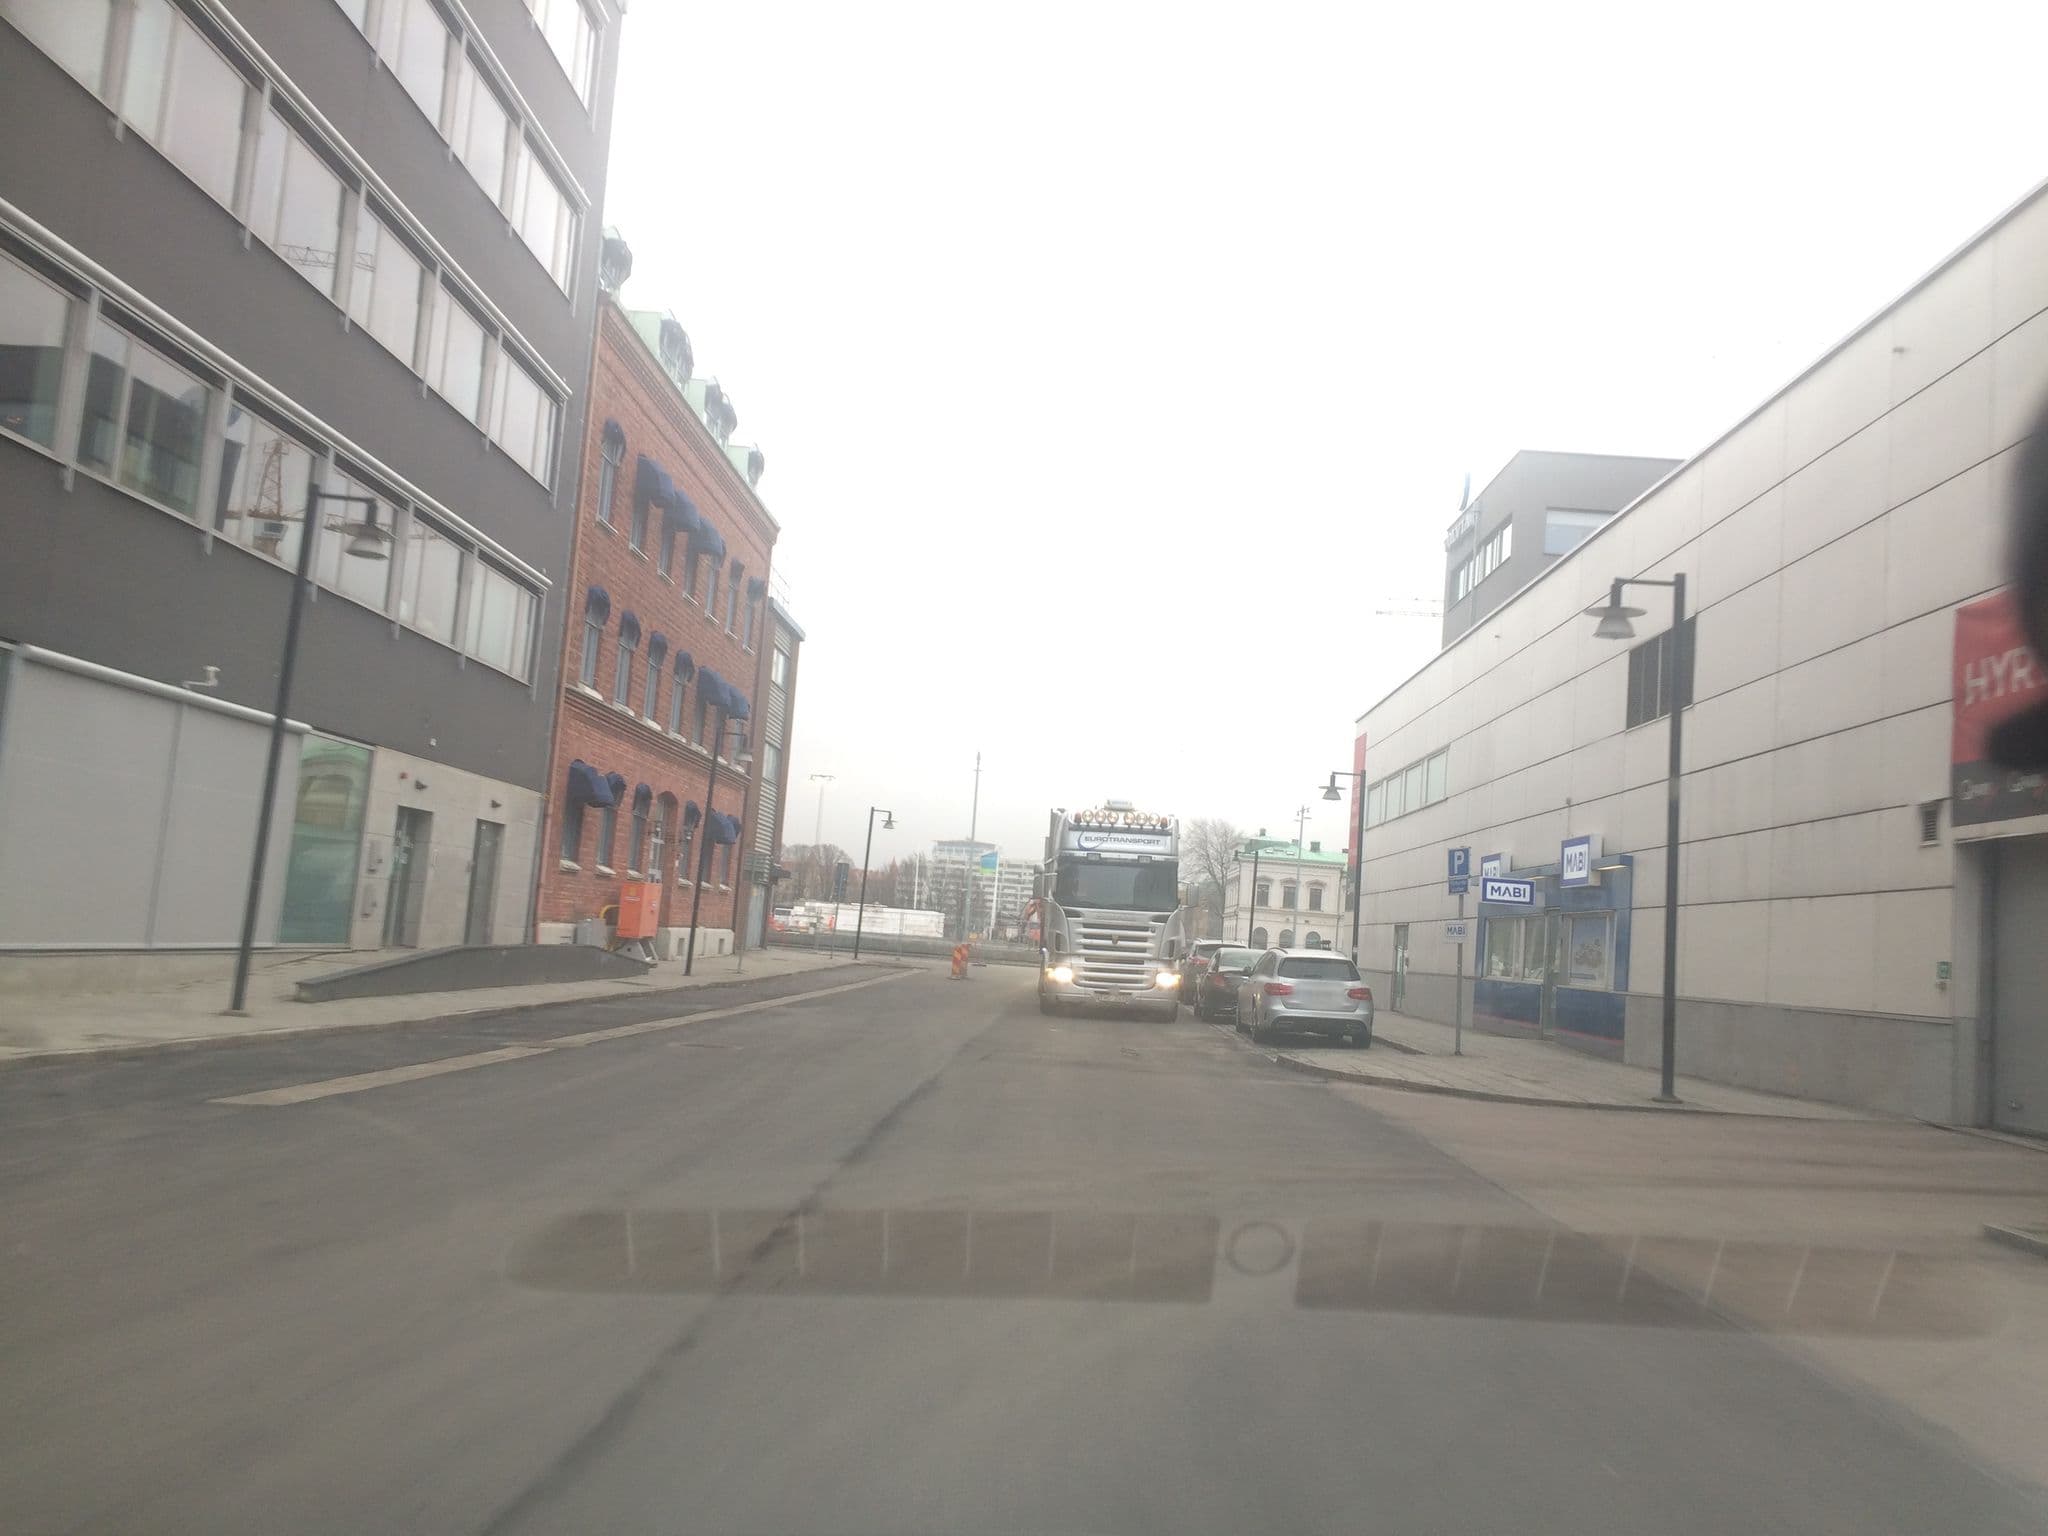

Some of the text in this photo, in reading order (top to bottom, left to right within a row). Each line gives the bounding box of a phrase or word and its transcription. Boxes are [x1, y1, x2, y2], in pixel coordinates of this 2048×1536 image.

[1964, 645, 2048, 705] HYR
[1084, 836, 1161, 846] EUROTRANSPORT
[1454, 850, 1465, 874] P
[1565, 850, 1586, 873] MABI
[1490, 885, 1526, 898] MABI
[1447, 926, 1465, 935] MABI
